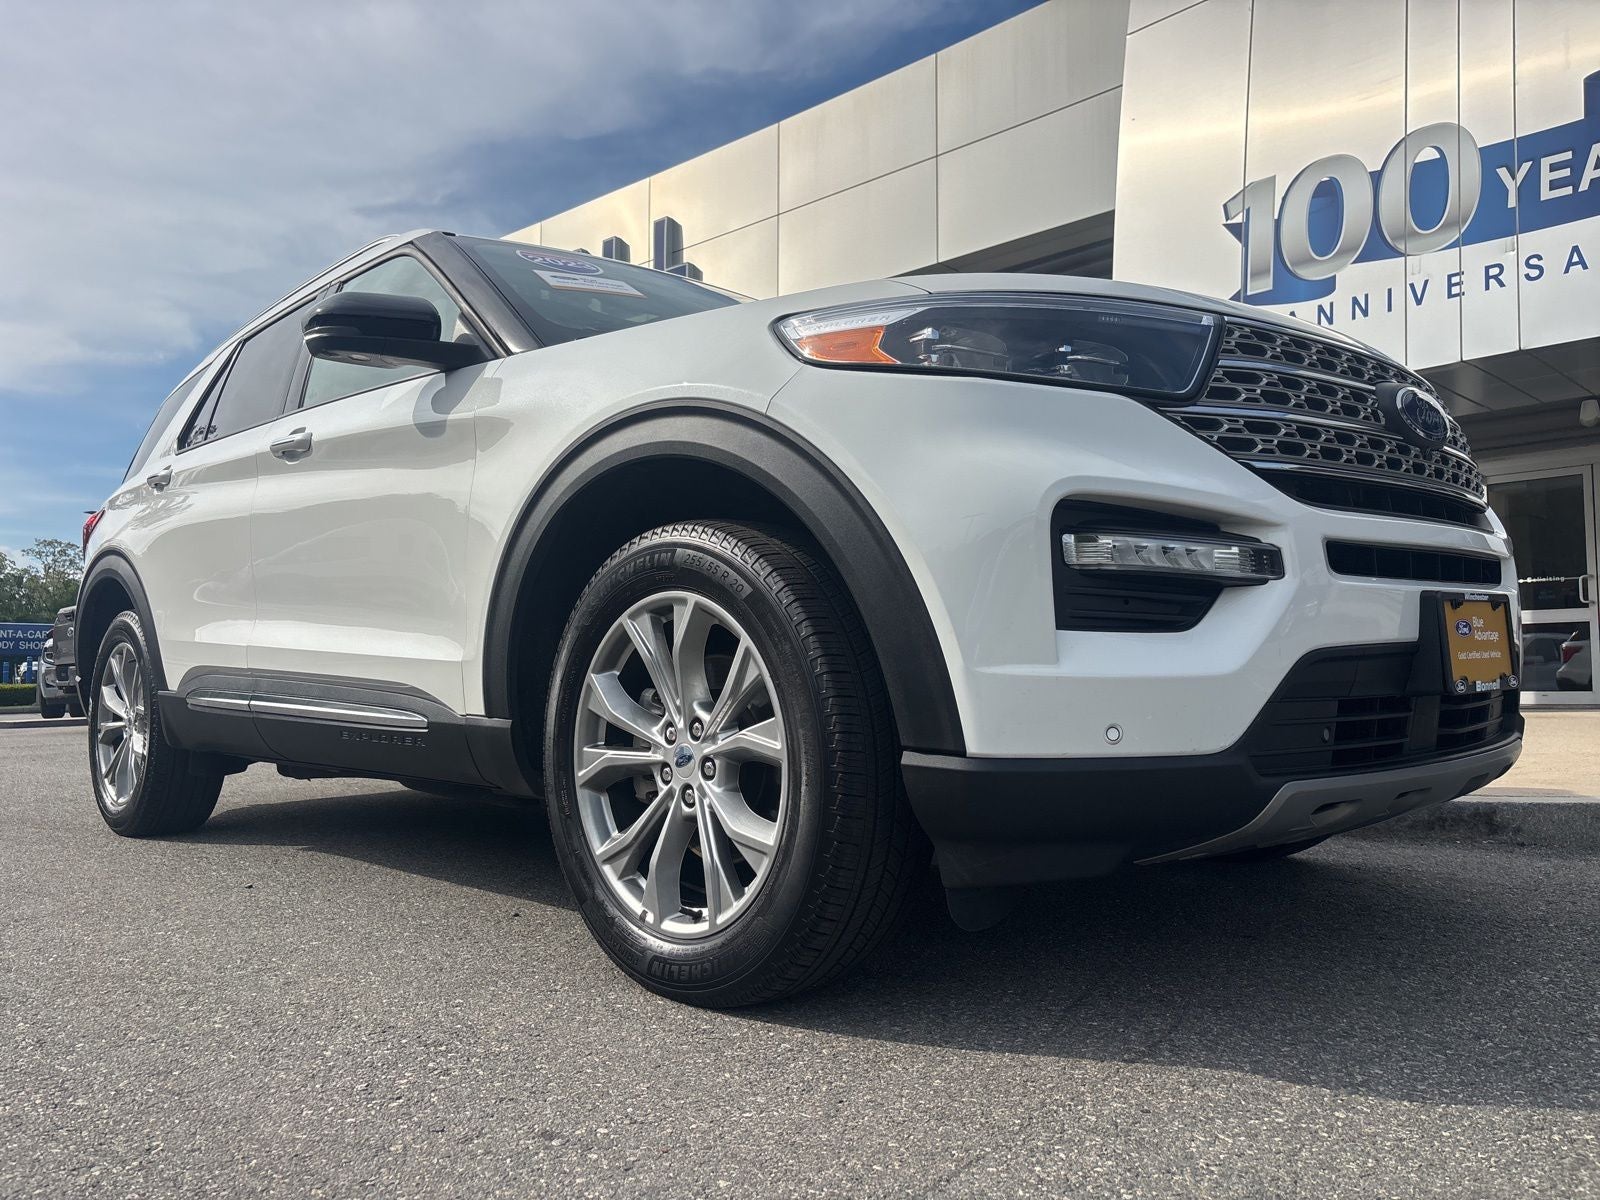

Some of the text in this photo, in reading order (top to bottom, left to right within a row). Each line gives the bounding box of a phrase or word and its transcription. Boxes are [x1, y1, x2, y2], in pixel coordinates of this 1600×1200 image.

[1223, 121, 1482, 296] 100
[1289, 244, 1589, 327] NNIVERSA
[720, 570, 730, 581] R
[730, 578, 745, 593] 20
[1472, 616, 1484, 628] Blue
[1474, 629, 1499, 643] Advantage
[0, 640, 15, 649] DY
[1475, 678, 1501, 692] Bonnell
[340, 730, 427, 747] EXPLORER
